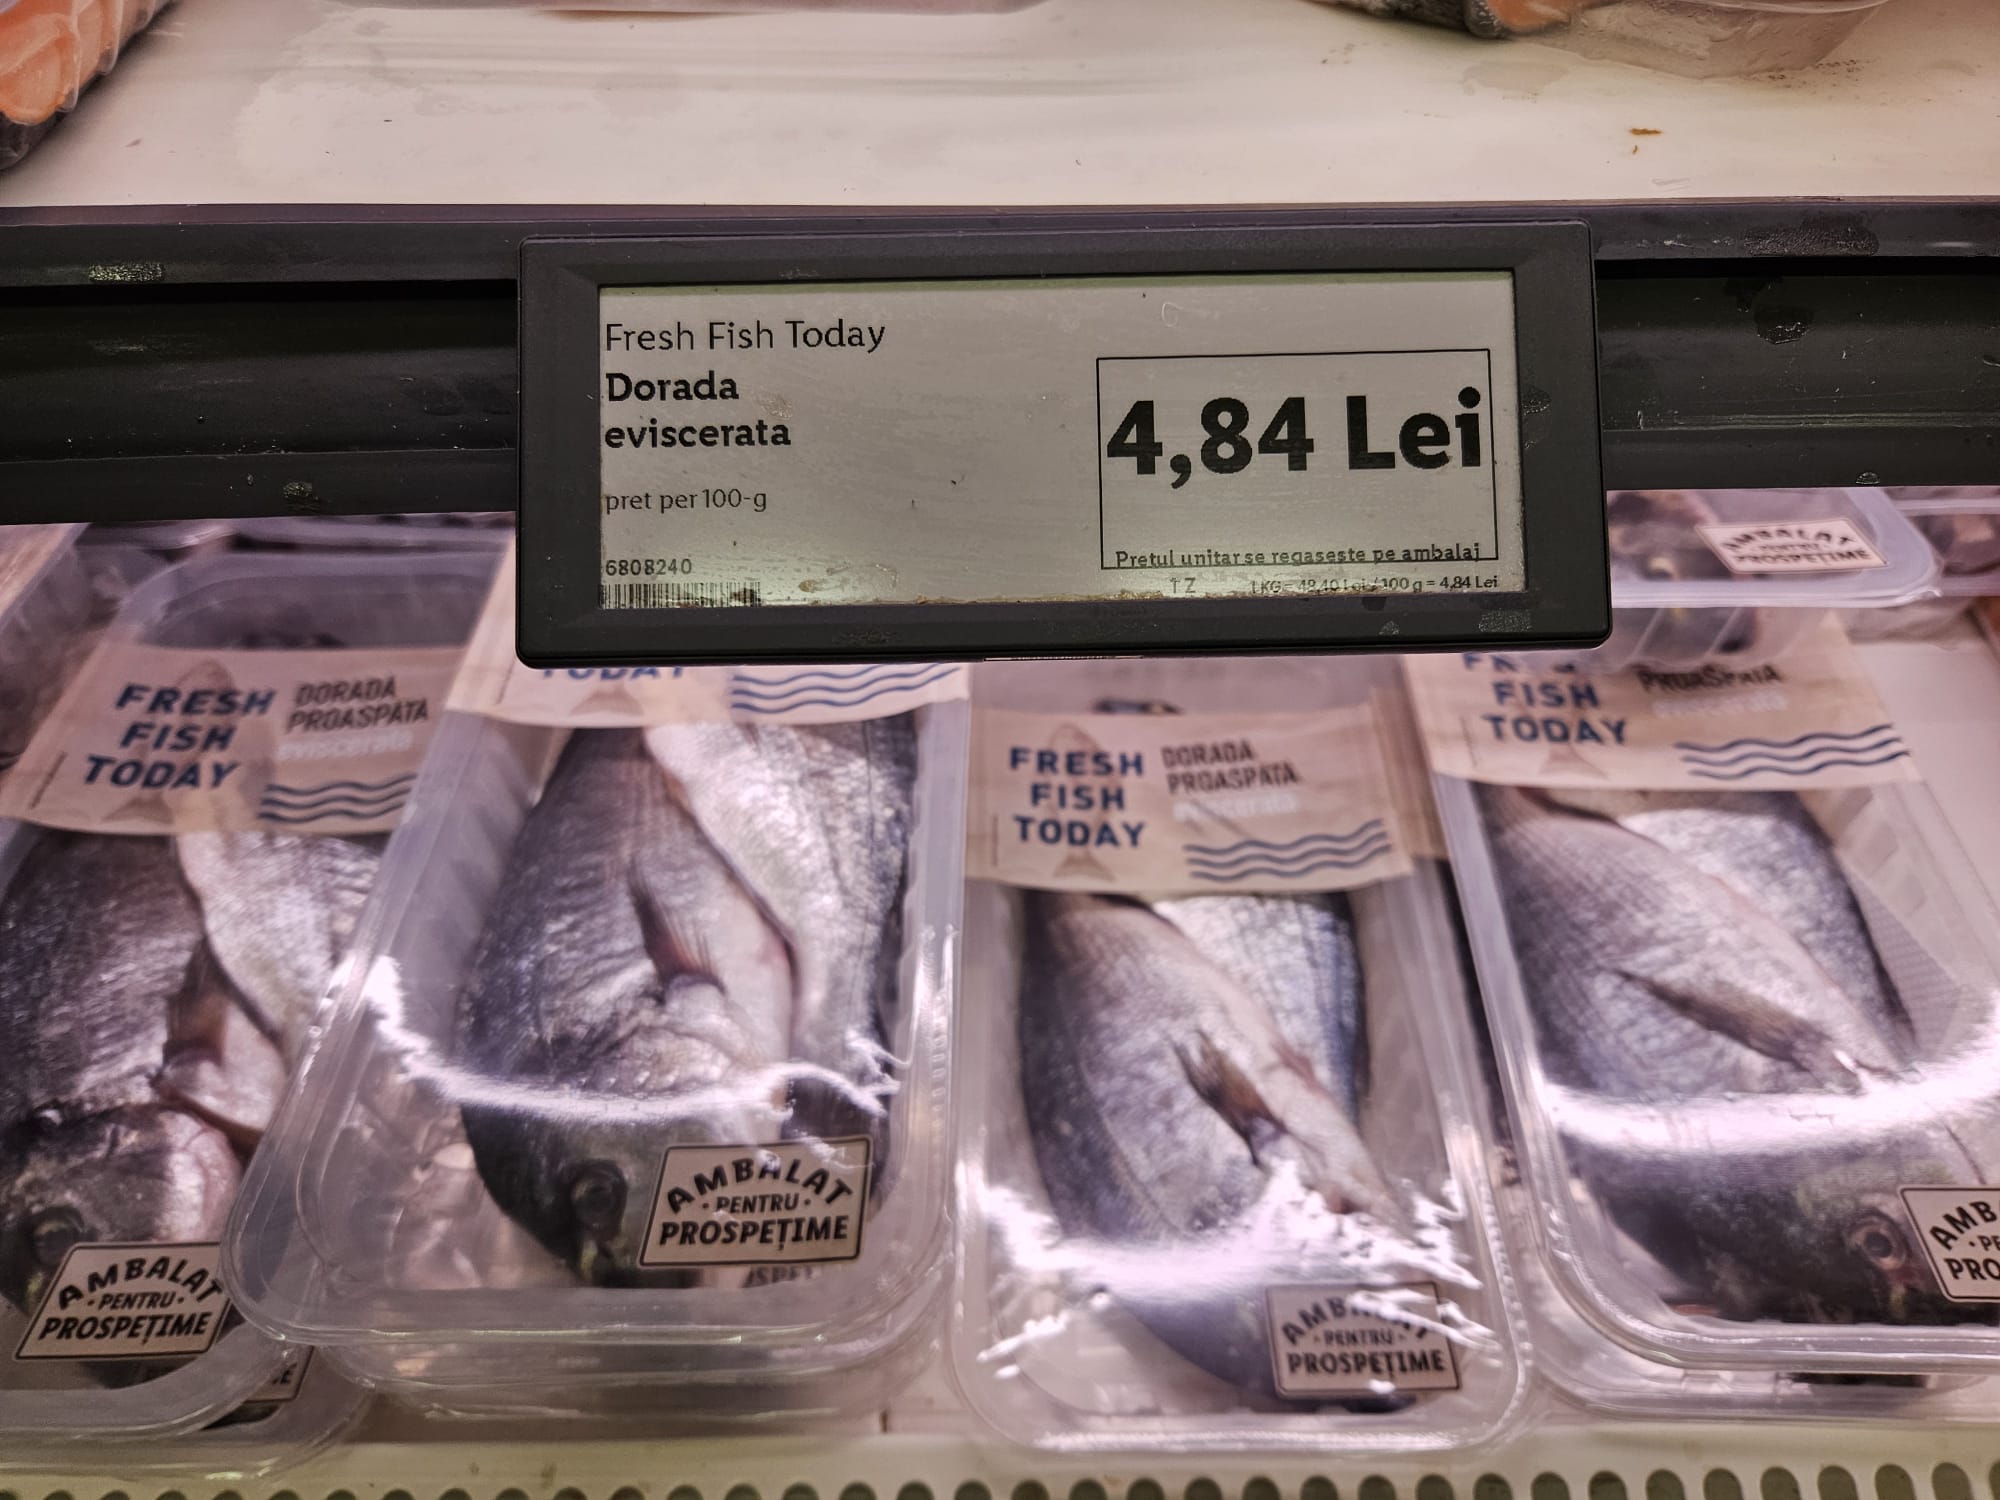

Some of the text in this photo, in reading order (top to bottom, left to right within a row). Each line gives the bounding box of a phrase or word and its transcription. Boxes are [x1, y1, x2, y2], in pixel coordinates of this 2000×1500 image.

[606, 319, 885, 353] Fresh Fish Today
[606, 371, 739, 401] Dorada
[605, 419, 791, 448] eviscerata
[1107, 386, 1481, 488] 4,84 Lei
[606, 489, 767, 514] pret per 100-g
[605, 558, 692, 576] 6808240
[1182, 549, 1240, 566] unitar
[1244, 552, 1265, 565] se
[1272, 549, 1366, 567] regaseste
[1373, 549, 1396, 565] pe
[1402, 543, 1479, 562] ambalaj
[1440, 576, 1471, 591] 4,84
[1476, 575, 1498, 588] Lei
[115, 683, 276, 716] FRESH
[1493, 681, 1598, 707] FISH
[119, 721, 237, 751] FISH
[1481, 715, 1625, 744] TODAY
[83, 755, 238, 789] TODAY
[1010, 747, 1144, 776] FRESH
[1031, 782, 1125, 811] FISH
[1013, 815, 1145, 847] TODAY
[667, 1158, 853, 1214] AMBALAT
[716, 1194, 800, 1214] PENTRU
[660, 1215, 849, 1250] PROSPEȚIME
[58, 1256, 223, 1310] AMBALAT
[98, 1292, 176, 1310] PENTRU
[38, 1312, 212, 1345] PROSPEȚIME
